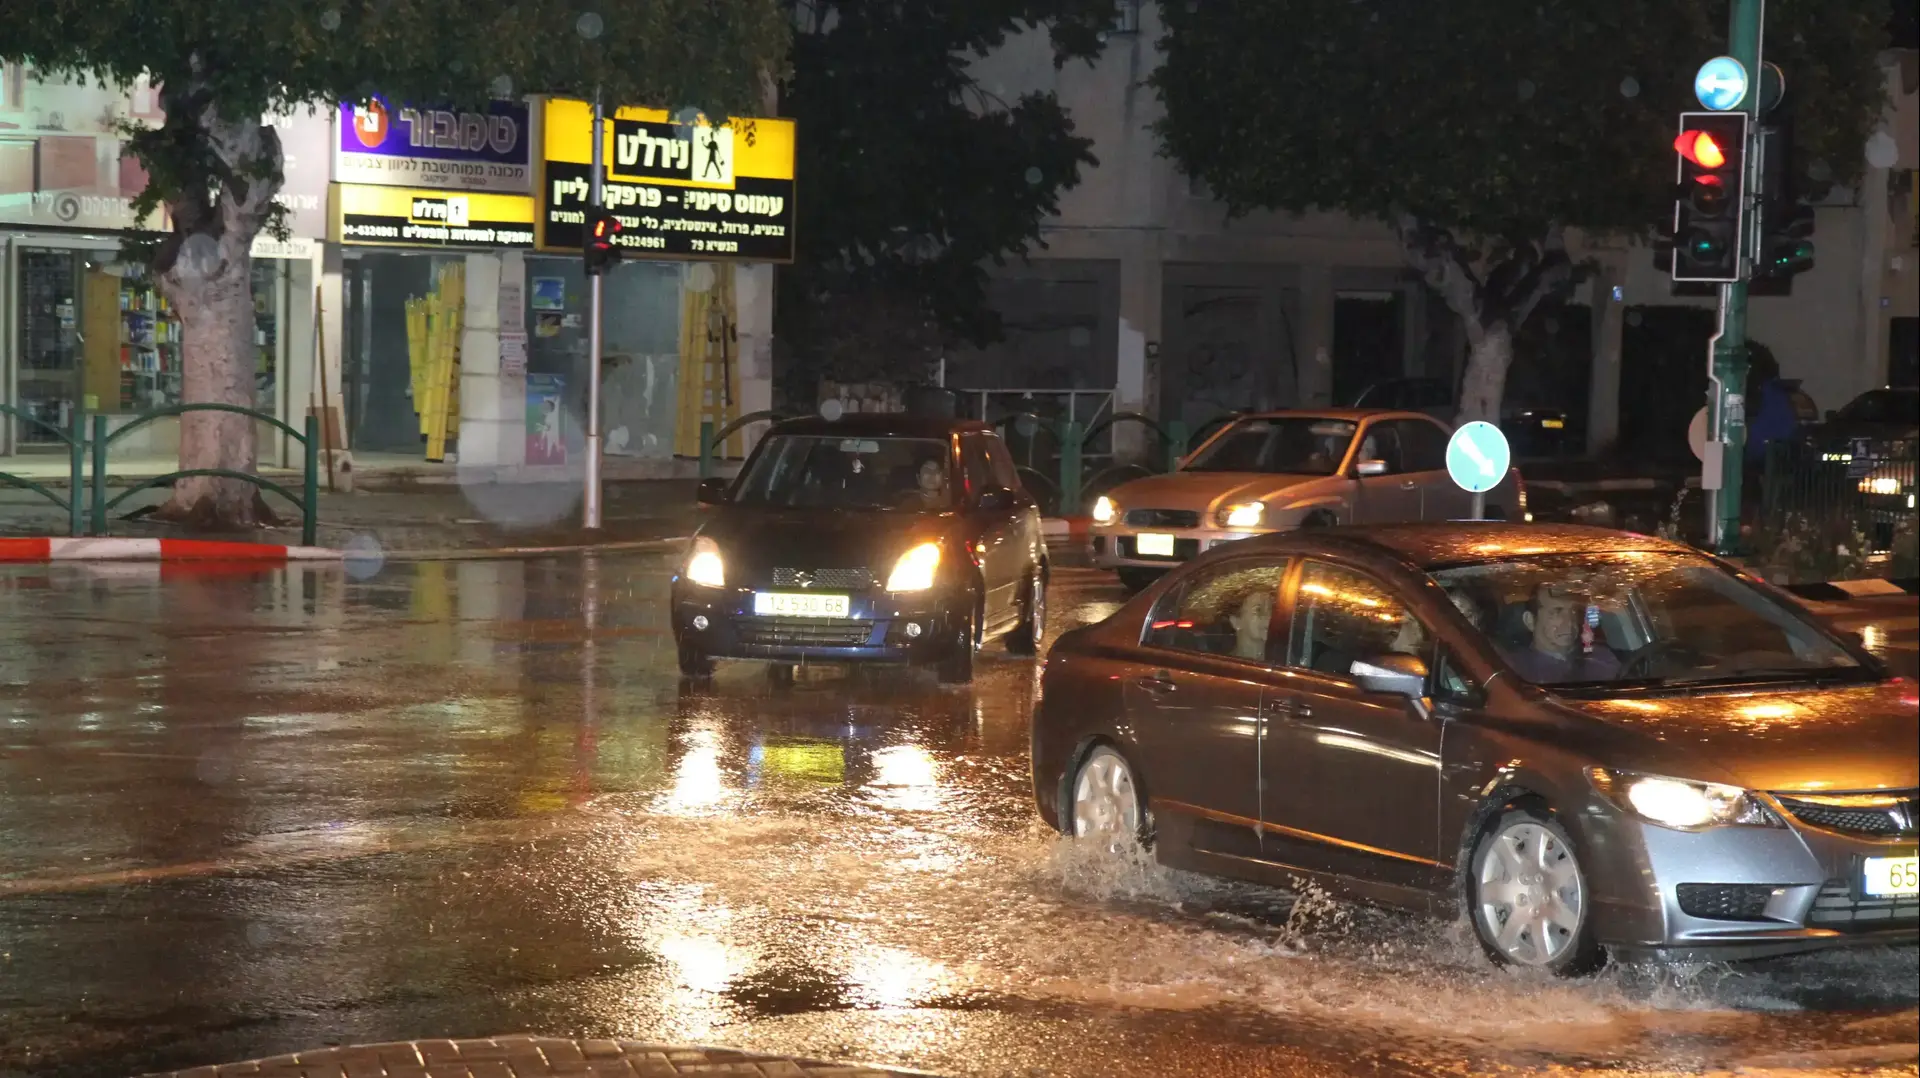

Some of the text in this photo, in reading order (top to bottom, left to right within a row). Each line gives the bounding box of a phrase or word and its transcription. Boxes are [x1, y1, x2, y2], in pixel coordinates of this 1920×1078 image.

[399, 107, 518, 154] טמבור
[617, 128, 689, 169] נירלט
[388, 157, 417, 171] לגיוון
[422, 161, 483, 177] ממוחשבת
[488, 164, 524, 179] מכונה
[553, 176, 589, 205] ליין
[80, 195, 130, 218] פרפקט
[734, 194, 784, 218] עמוס
[611, 215, 640, 228] עבוד
[641, 215, 658, 229] כלי
[608, 234, 738, 253] הנשיא 79 4-6324961
[770, 596, 843, 612] 12 530 68
[1890, 862, 1918, 888] 65
